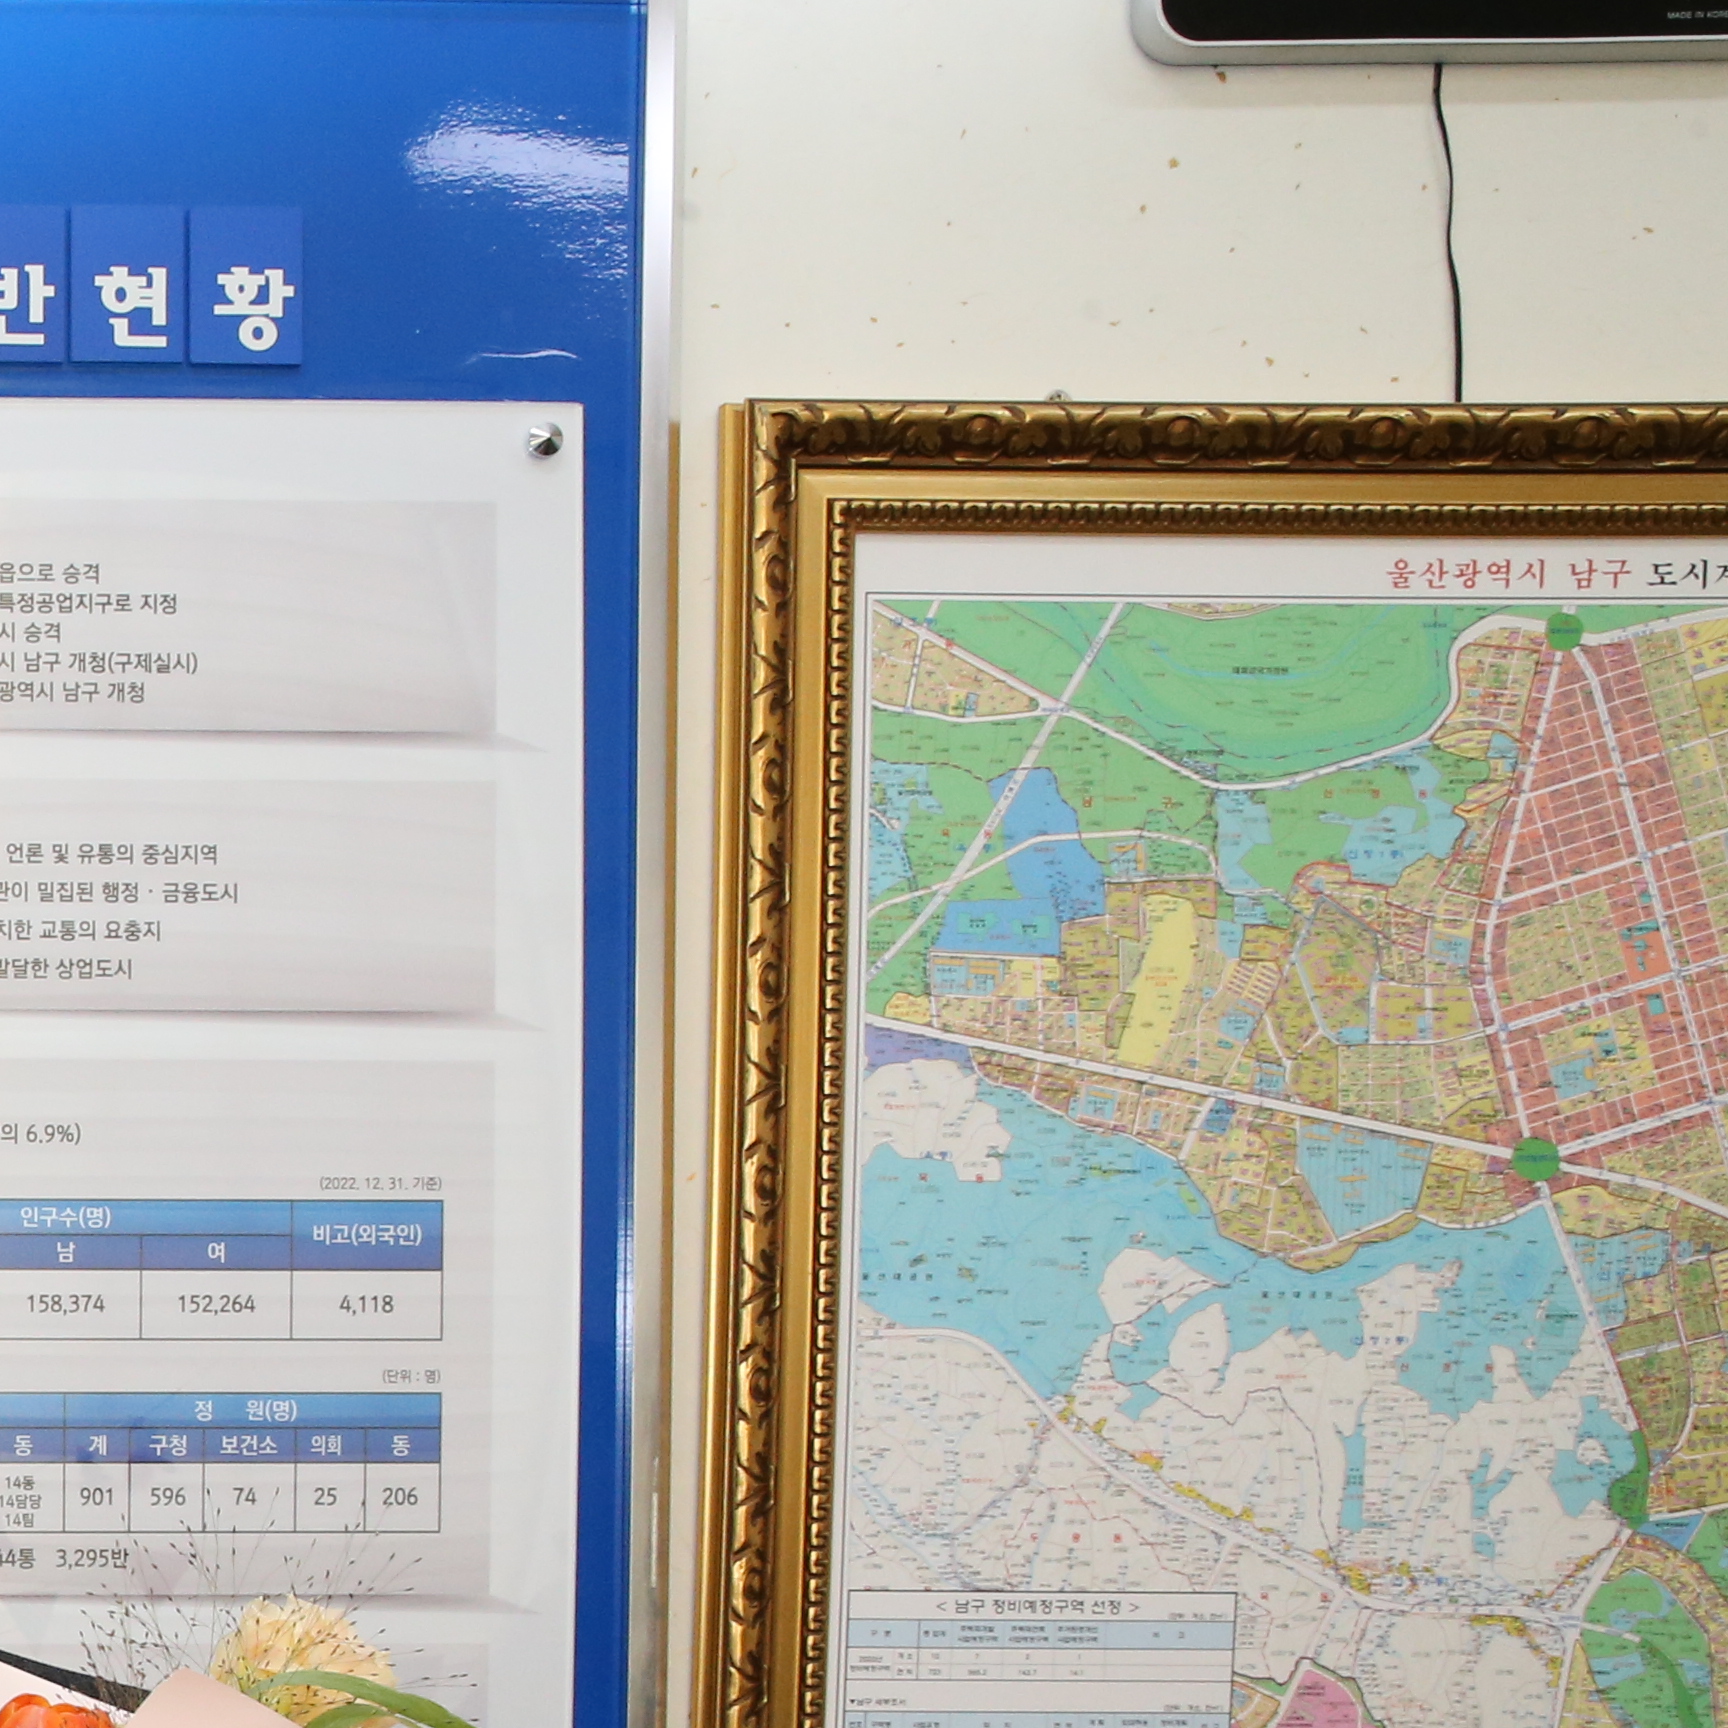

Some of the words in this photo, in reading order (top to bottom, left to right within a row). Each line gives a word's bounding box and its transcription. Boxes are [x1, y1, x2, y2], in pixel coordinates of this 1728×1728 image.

[1385, 557, 1545, 590] 울산광역시
[1568, 557, 1632, 590] 남구
[139, 593, 177, 615] 지정
[23, 651, 62, 673] 남구
[68, 651, 198, 675] 개청(구제실시)
[37, 881, 94, 903] 밀집된
[101, 881, 139, 904] 행정
[161, 881, 238, 905] 금융도시
[54, 957, 132, 981] 상업도시
[26, 1122, 81, 1146] 6.9%)
[20, 1205, 111, 1229] 인구수(명)
[313, 1223, 422, 1247] 비고(외국인)
[56, 1241, 76, 1263] 남
[207, 1241, 225, 1264] 여
[27, 1294, 106, 1316] 158,374
[178, 1294, 256, 1316] 152,264
[339, 1294, 394, 1316] 4,118
[149, 1434, 187, 1457] 구청
[219, 1434, 278, 1456] 보건소
[79, 1486, 113, 1506] 901
[150, 1486, 186, 1507] 596
[382, 1486, 419, 1508] 206
[954, 1599, 986, 1615] 남구
[1090, 1600, 1122, 1616] 선정
